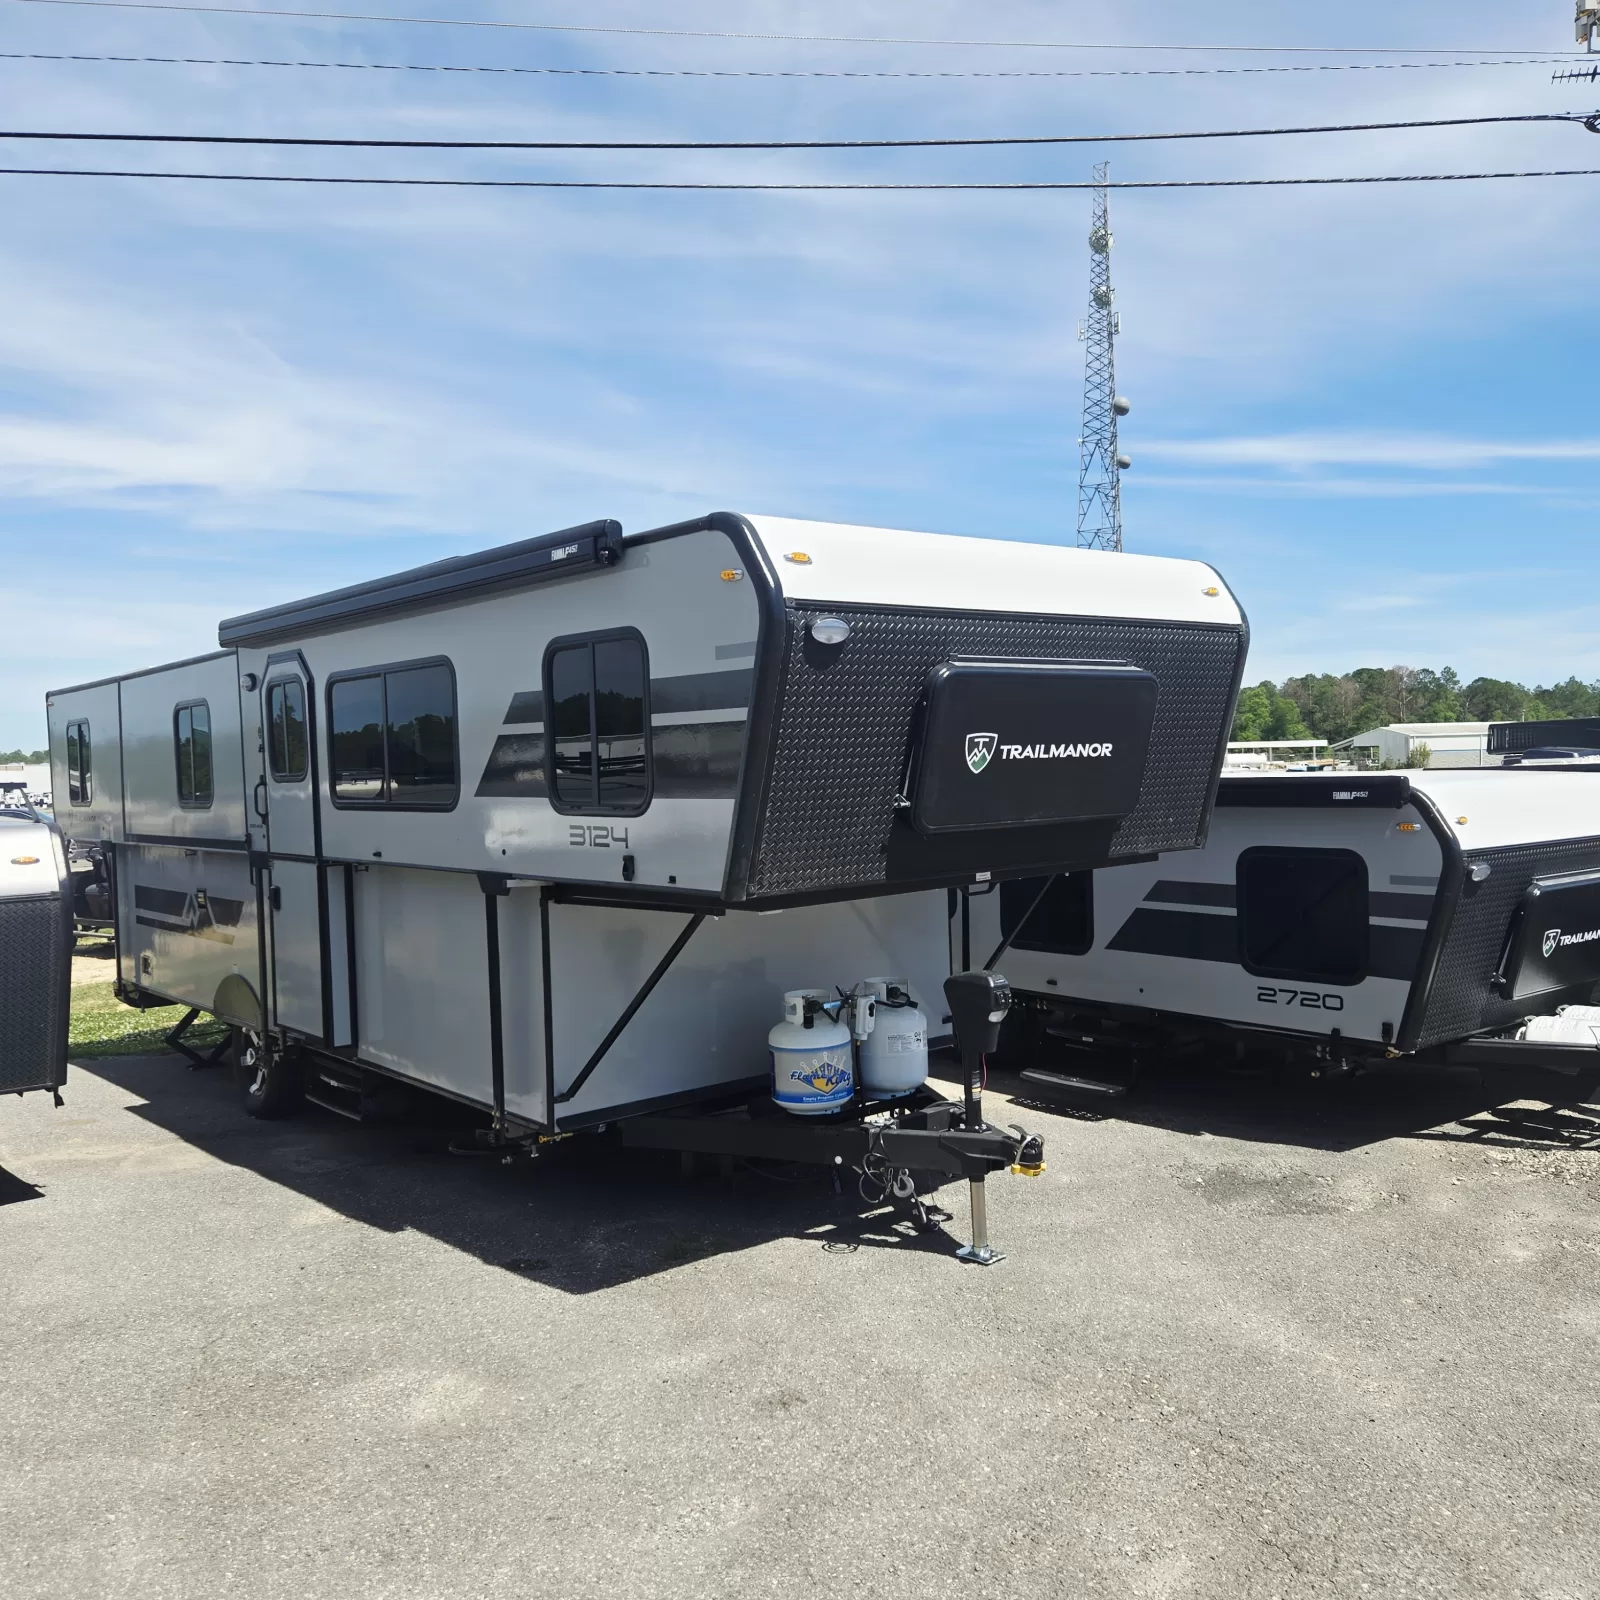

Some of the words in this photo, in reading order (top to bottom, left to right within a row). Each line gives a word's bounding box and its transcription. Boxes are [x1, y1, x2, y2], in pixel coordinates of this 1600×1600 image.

[1000, 743, 1113, 759] TRAILMANOR
[569, 824, 629, 849] 3124
[1257, 986, 1344, 1011] 2720
